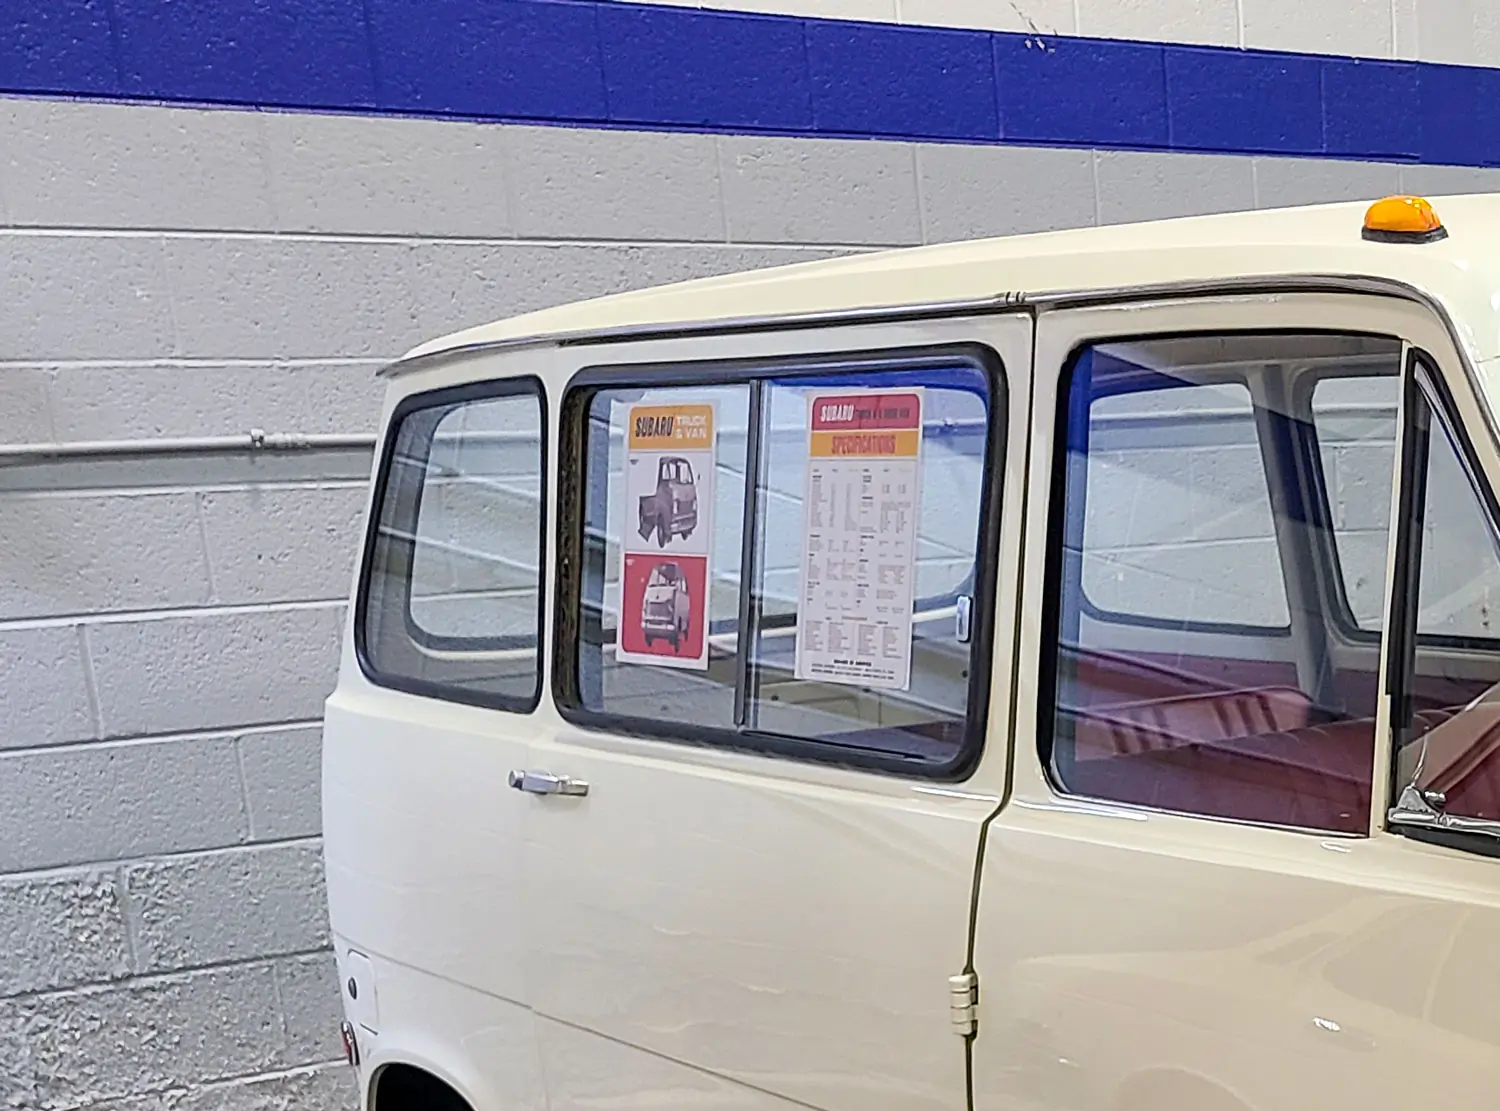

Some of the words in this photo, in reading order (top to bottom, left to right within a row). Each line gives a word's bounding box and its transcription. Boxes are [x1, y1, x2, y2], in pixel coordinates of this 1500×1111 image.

[677, 415, 706, 426] TRUCK
[820, 404, 855, 422] SUBARU
[635, 415, 674, 437] SUBARU
[687, 427, 707, 439] VAN
[831, 435, 896, 455] SPECIFICATIONS
